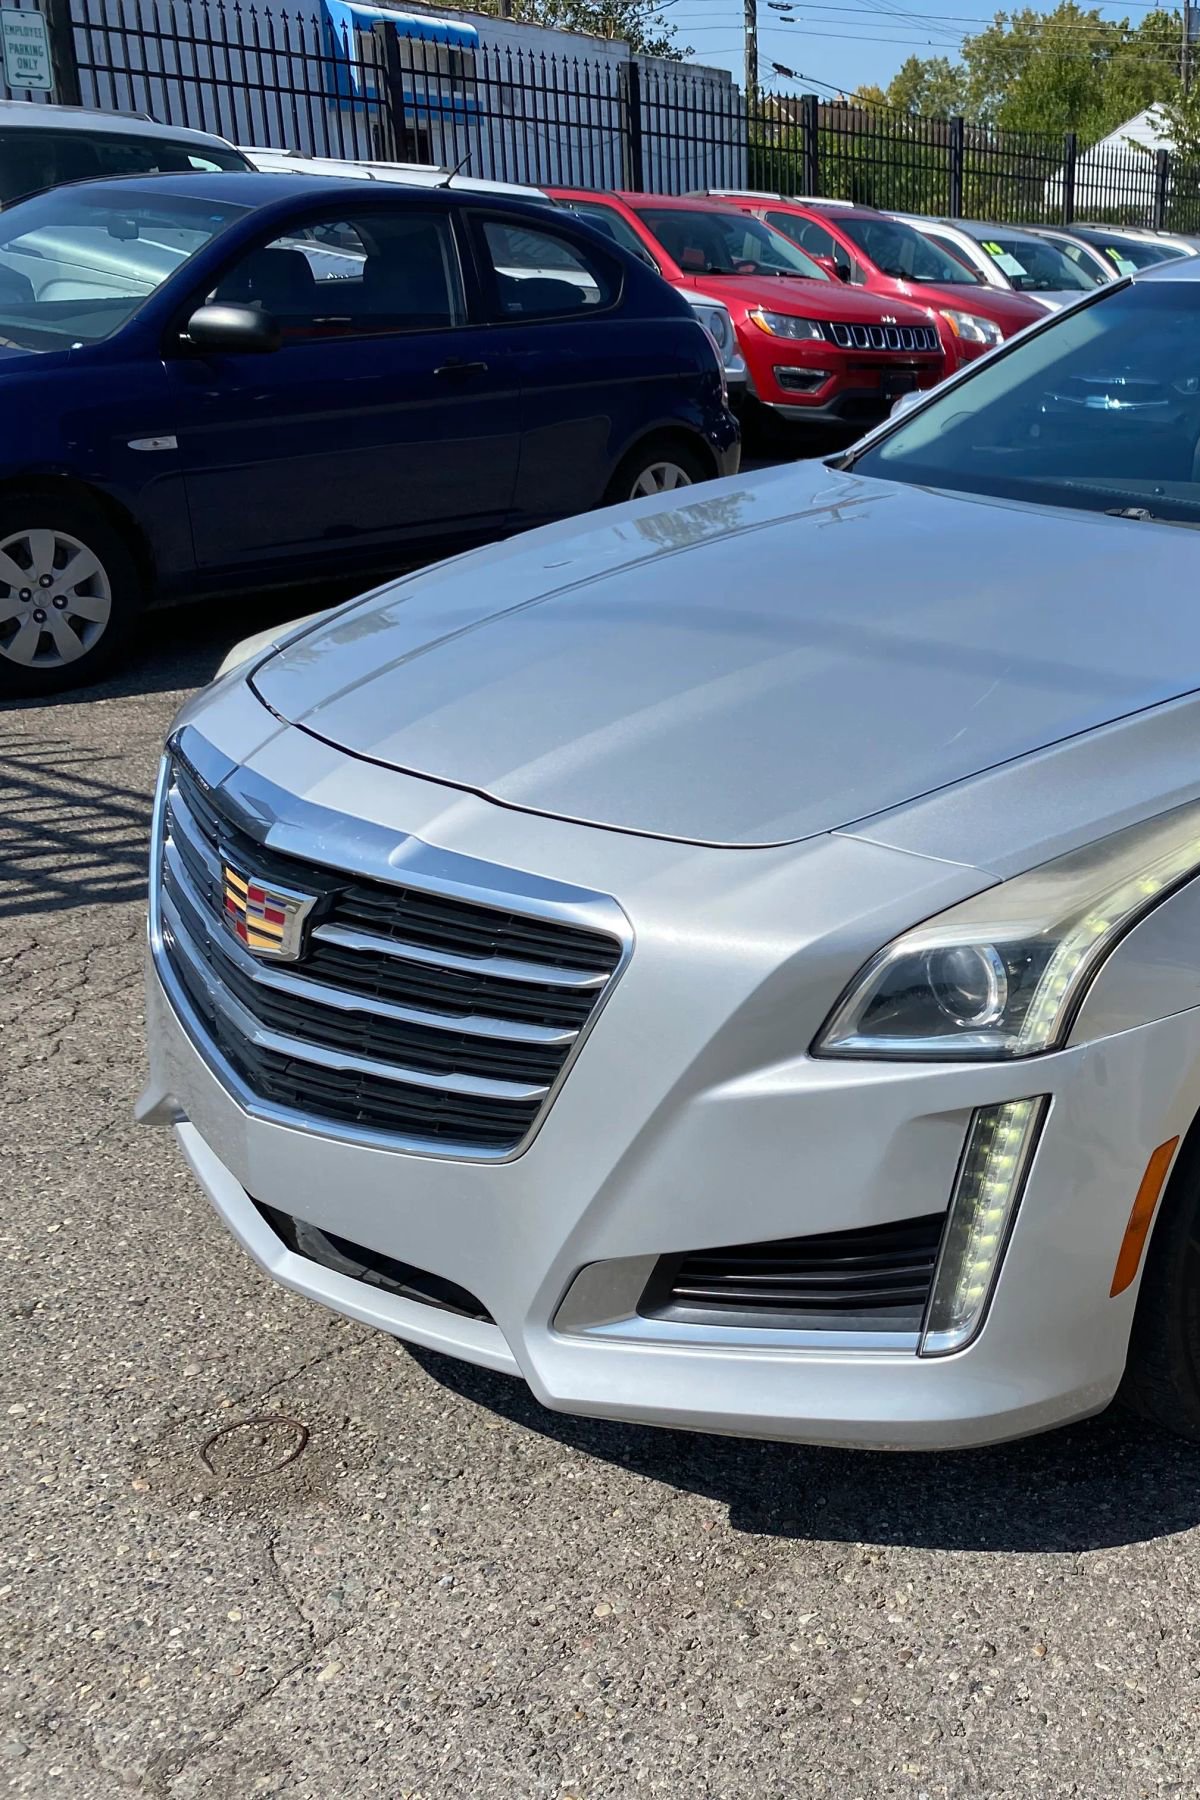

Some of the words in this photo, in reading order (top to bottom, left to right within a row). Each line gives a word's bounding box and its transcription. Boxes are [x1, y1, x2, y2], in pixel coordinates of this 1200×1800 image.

[4, 24, 43, 38] EMPLOYEE
[8, 43, 44, 56] PARKING
[17, 57, 38, 70] ONLY
